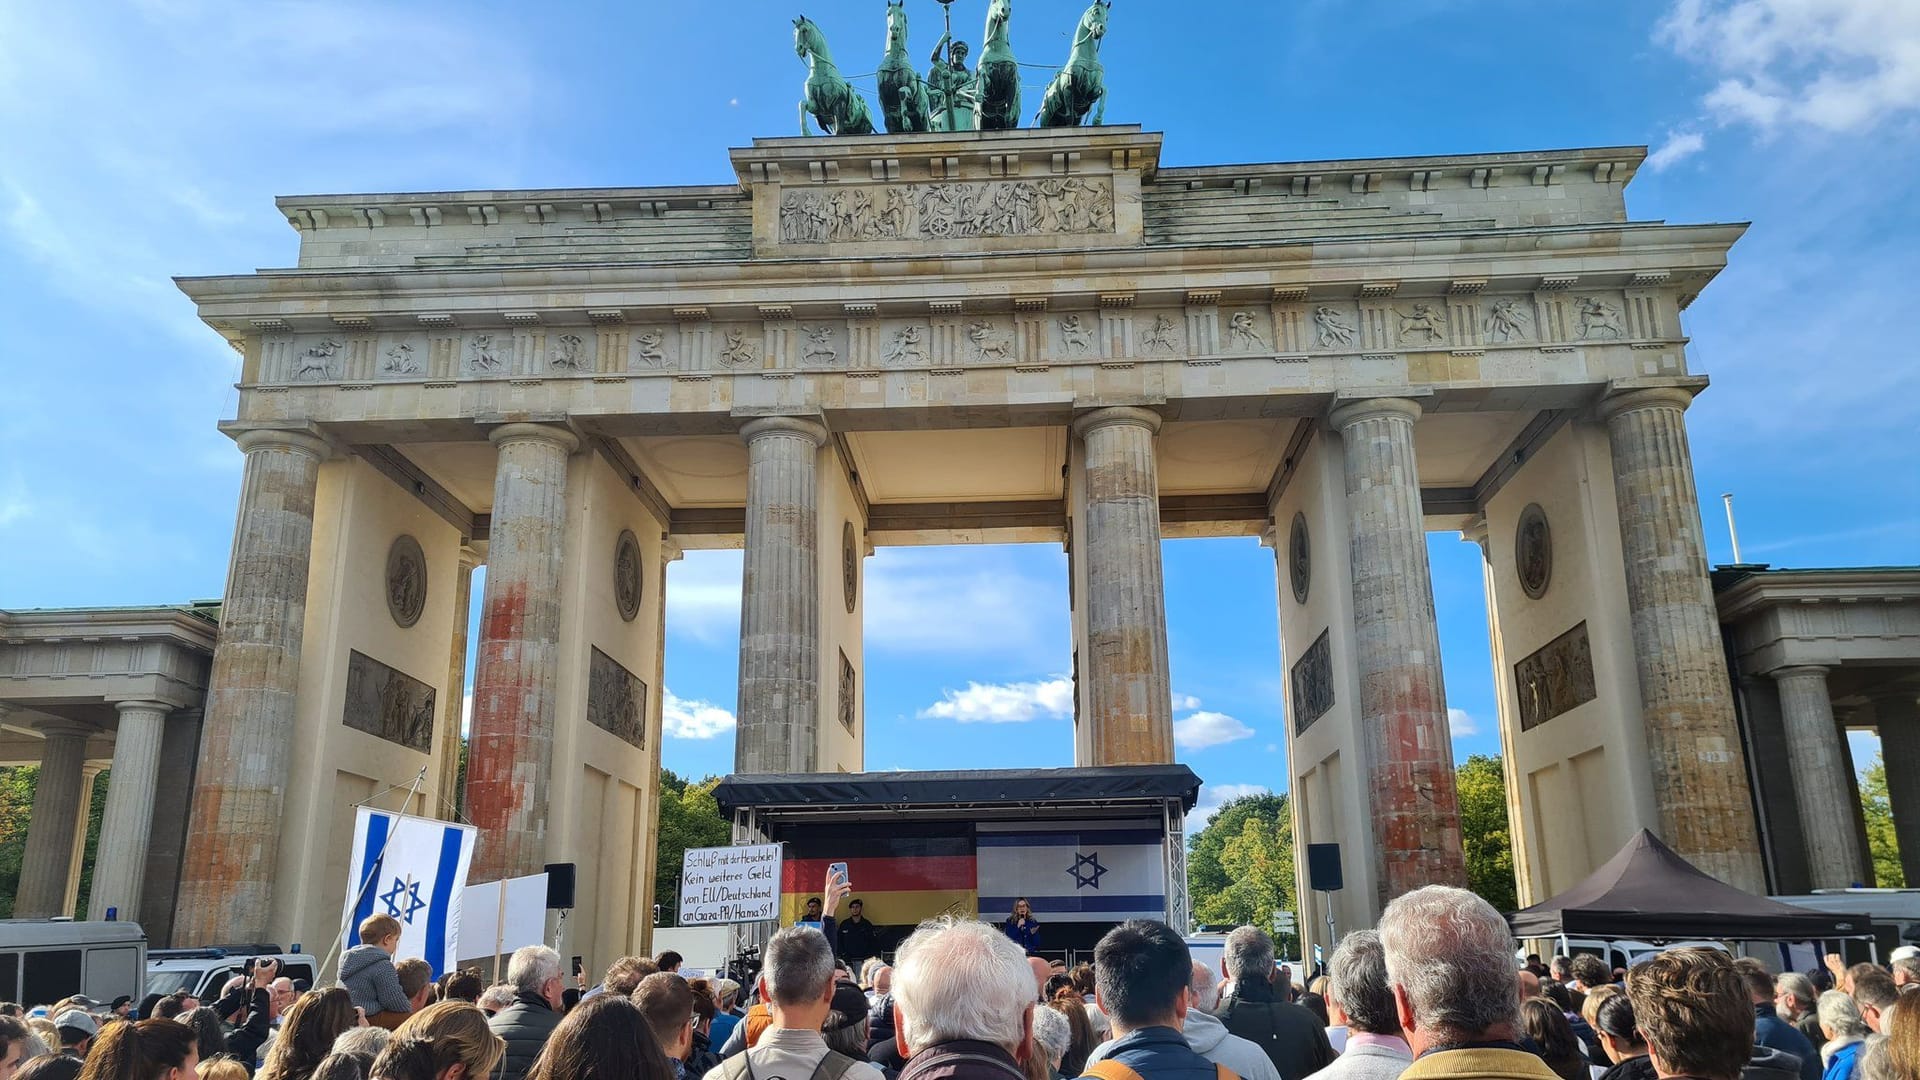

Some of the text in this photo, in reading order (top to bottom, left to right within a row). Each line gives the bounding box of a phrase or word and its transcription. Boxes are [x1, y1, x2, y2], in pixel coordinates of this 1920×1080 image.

[686, 851, 718, 869] Schluß
[718, 854, 729, 865] mit
[730, 851, 741, 864] der
[684, 865, 772, 886] Kein weiteres Geld
[684, 885, 772, 905] von EU/Deutschland
[683, 911, 694, 921] an
